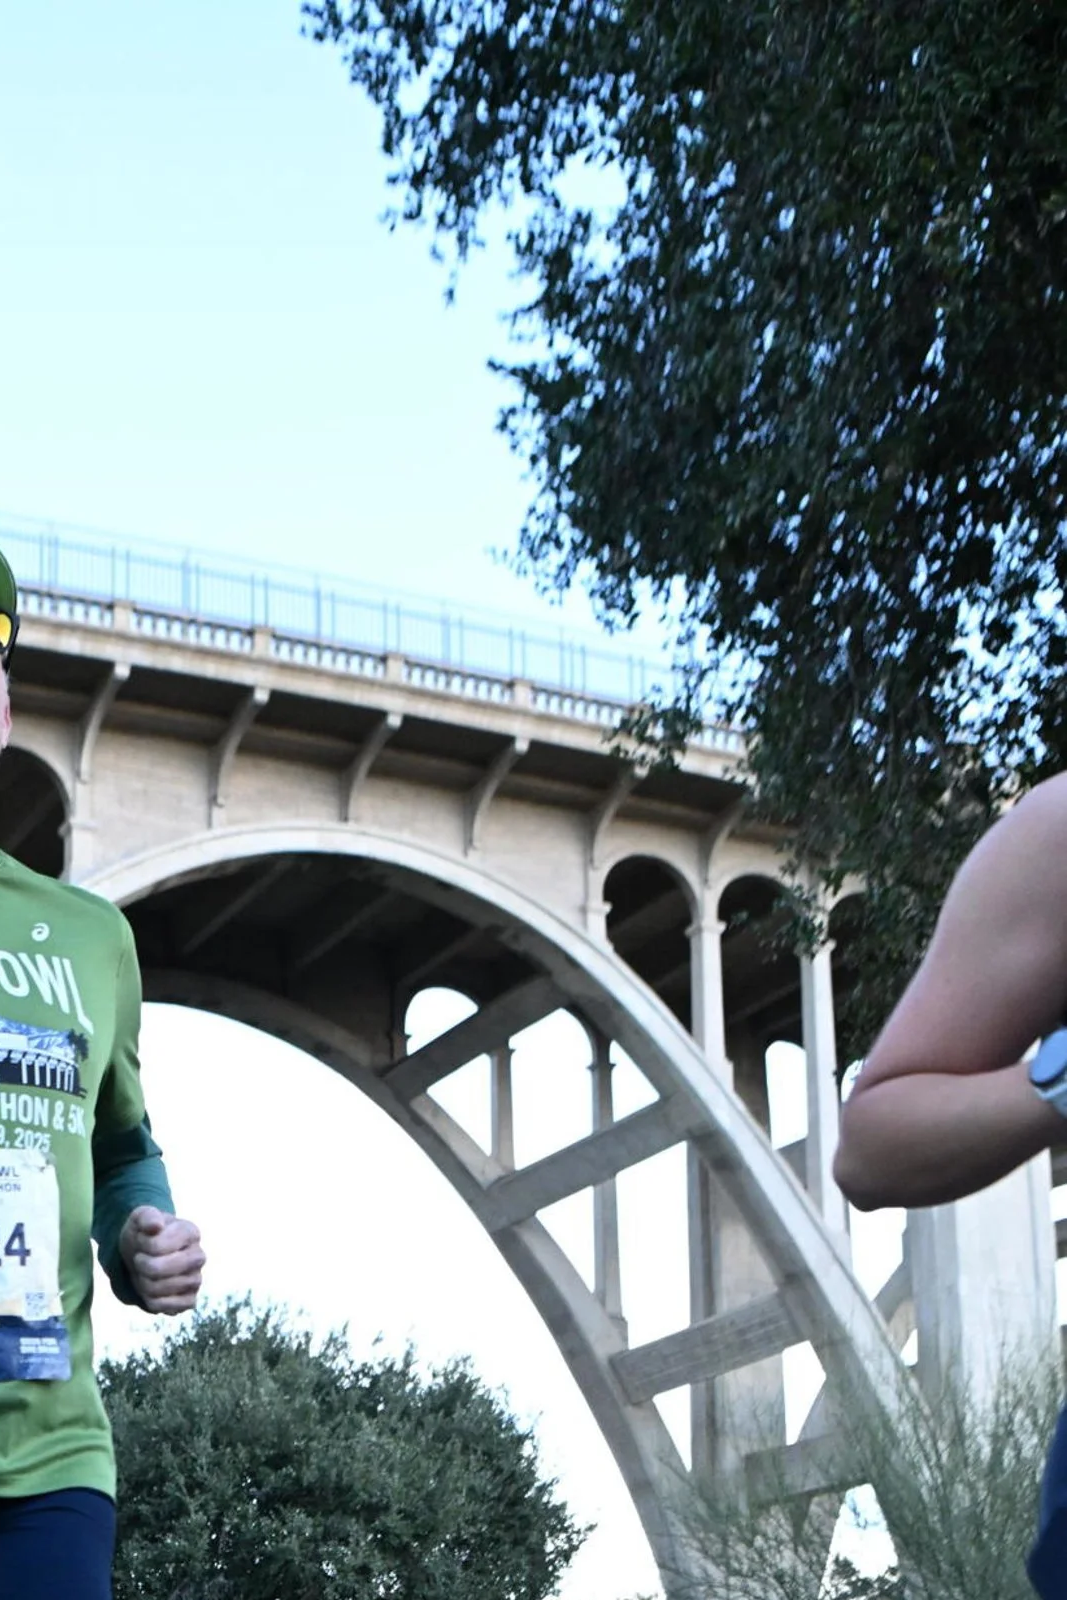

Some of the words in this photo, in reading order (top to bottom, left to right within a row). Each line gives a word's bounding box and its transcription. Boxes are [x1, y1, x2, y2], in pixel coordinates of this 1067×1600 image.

[52, 1101, 65, 1131] &
[67, 1103, 86, 1138] 5K
[14, 1128, 52, 1152] 2025
